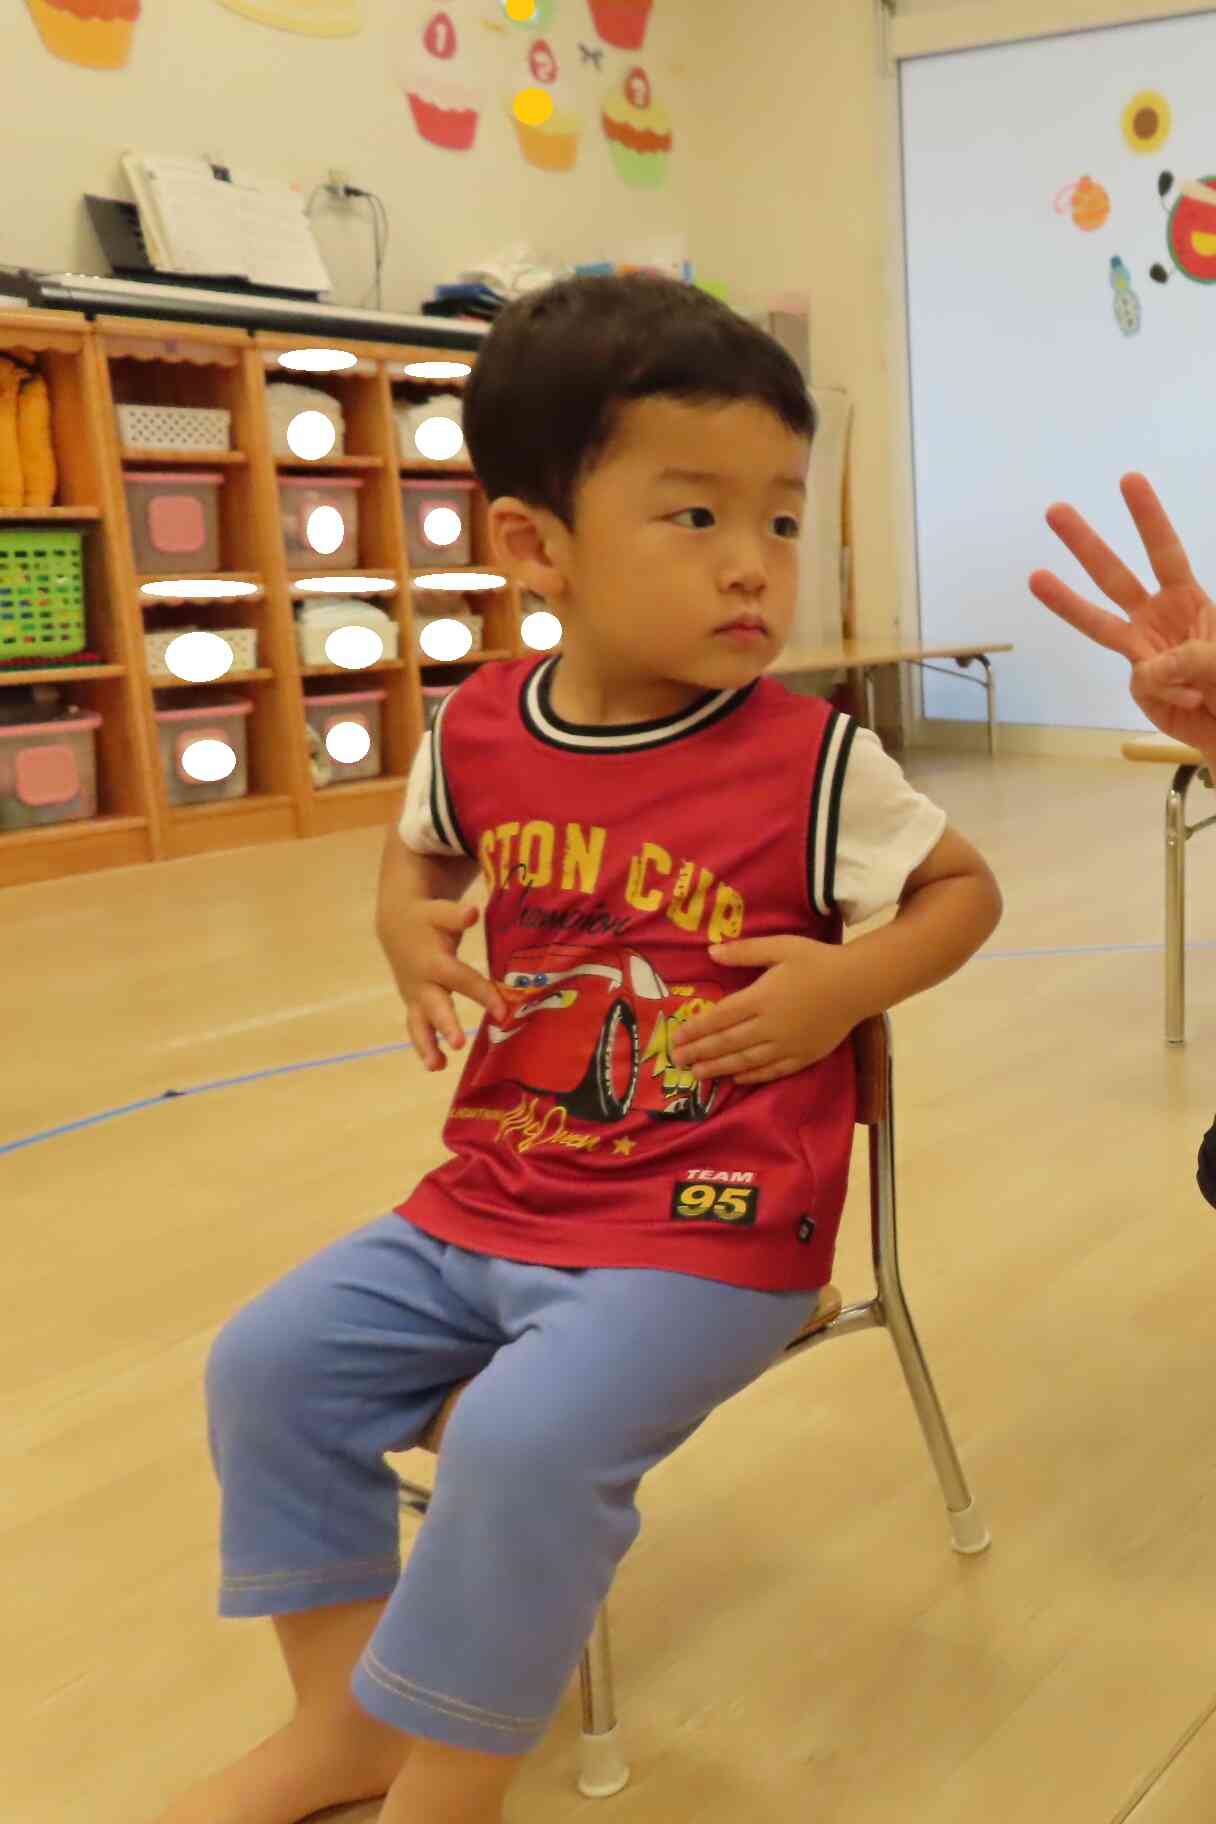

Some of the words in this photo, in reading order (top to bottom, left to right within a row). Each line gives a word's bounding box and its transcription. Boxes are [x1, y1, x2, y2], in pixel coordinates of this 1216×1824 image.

[624, 842, 744, 944] CUP
[686, 1168, 754, 1183] TEAM
[676, 1183, 753, 1220] 95
